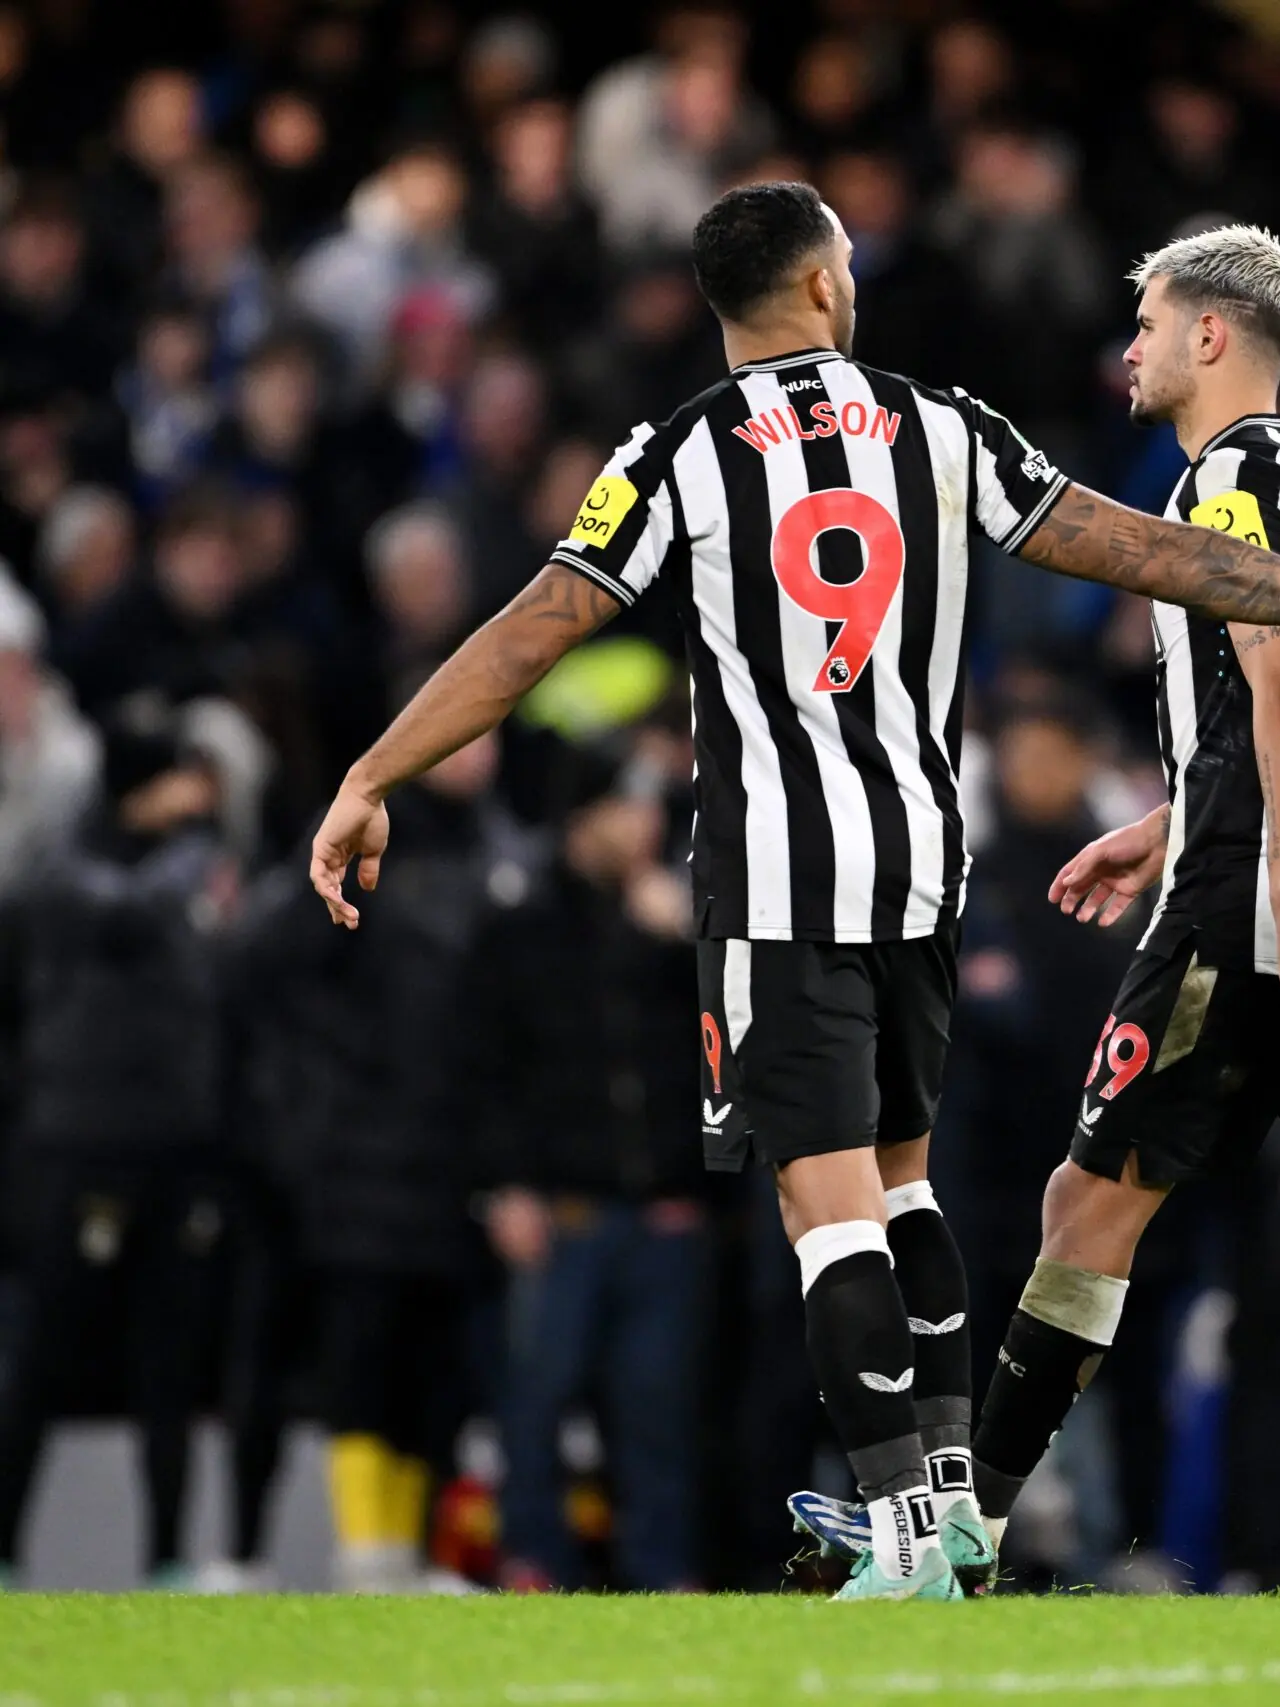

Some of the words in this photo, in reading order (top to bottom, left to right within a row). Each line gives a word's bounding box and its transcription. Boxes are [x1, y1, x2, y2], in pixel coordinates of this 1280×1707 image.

[780, 379, 823, 393] NUFC
[731, 401, 902, 454] WILSON
[573, 515, 610, 536] oon
[771, 487, 906, 693] 9
[701, 1011, 722, 1093] 9
[889, 1494, 914, 1577] APEDESIGN
